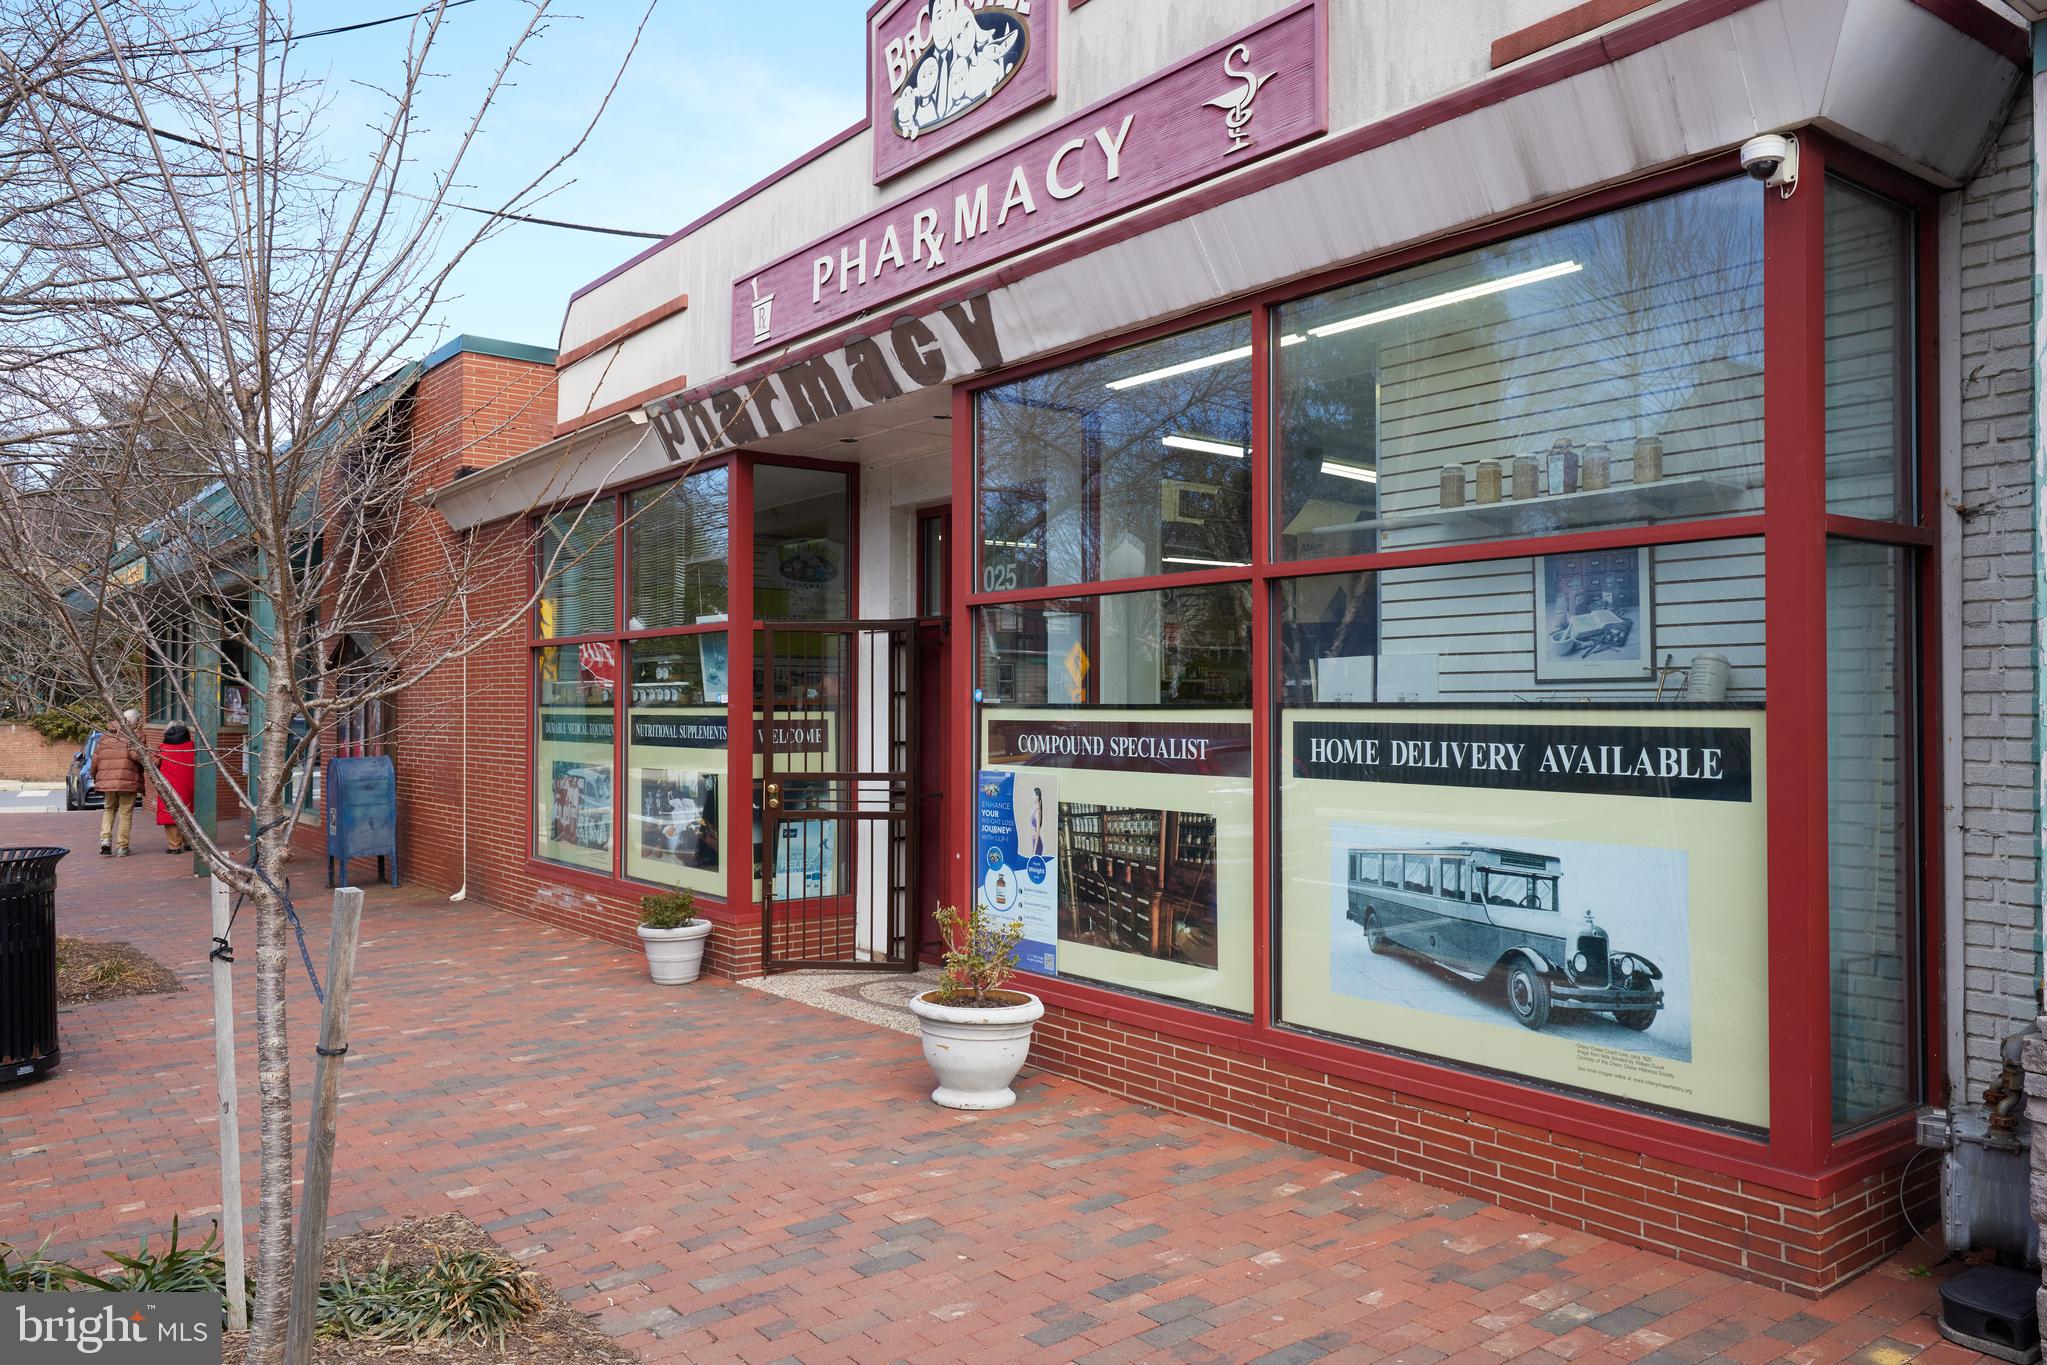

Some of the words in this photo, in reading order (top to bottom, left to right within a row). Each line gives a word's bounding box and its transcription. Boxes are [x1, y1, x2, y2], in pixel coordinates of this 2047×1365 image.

[984, 563, 1017, 592] 025
[568, 722, 588, 734] MEDICAL
[590, 723, 614, 738] EQUIPMEN
[636, 724, 678, 738] NUTRITIONAL
[1018, 734, 1104, 756] COMPOUND
[1110, 736, 1208, 760] SPECIALIST
[1310, 738, 1379, 765] HOME
[1390, 740, 1525, 771] DELIVERY
[1538, 744, 1722, 780] AVAILABLE
[981, 800, 1010, 810] ENHANCE
[982, 810, 999, 818] YOUR
